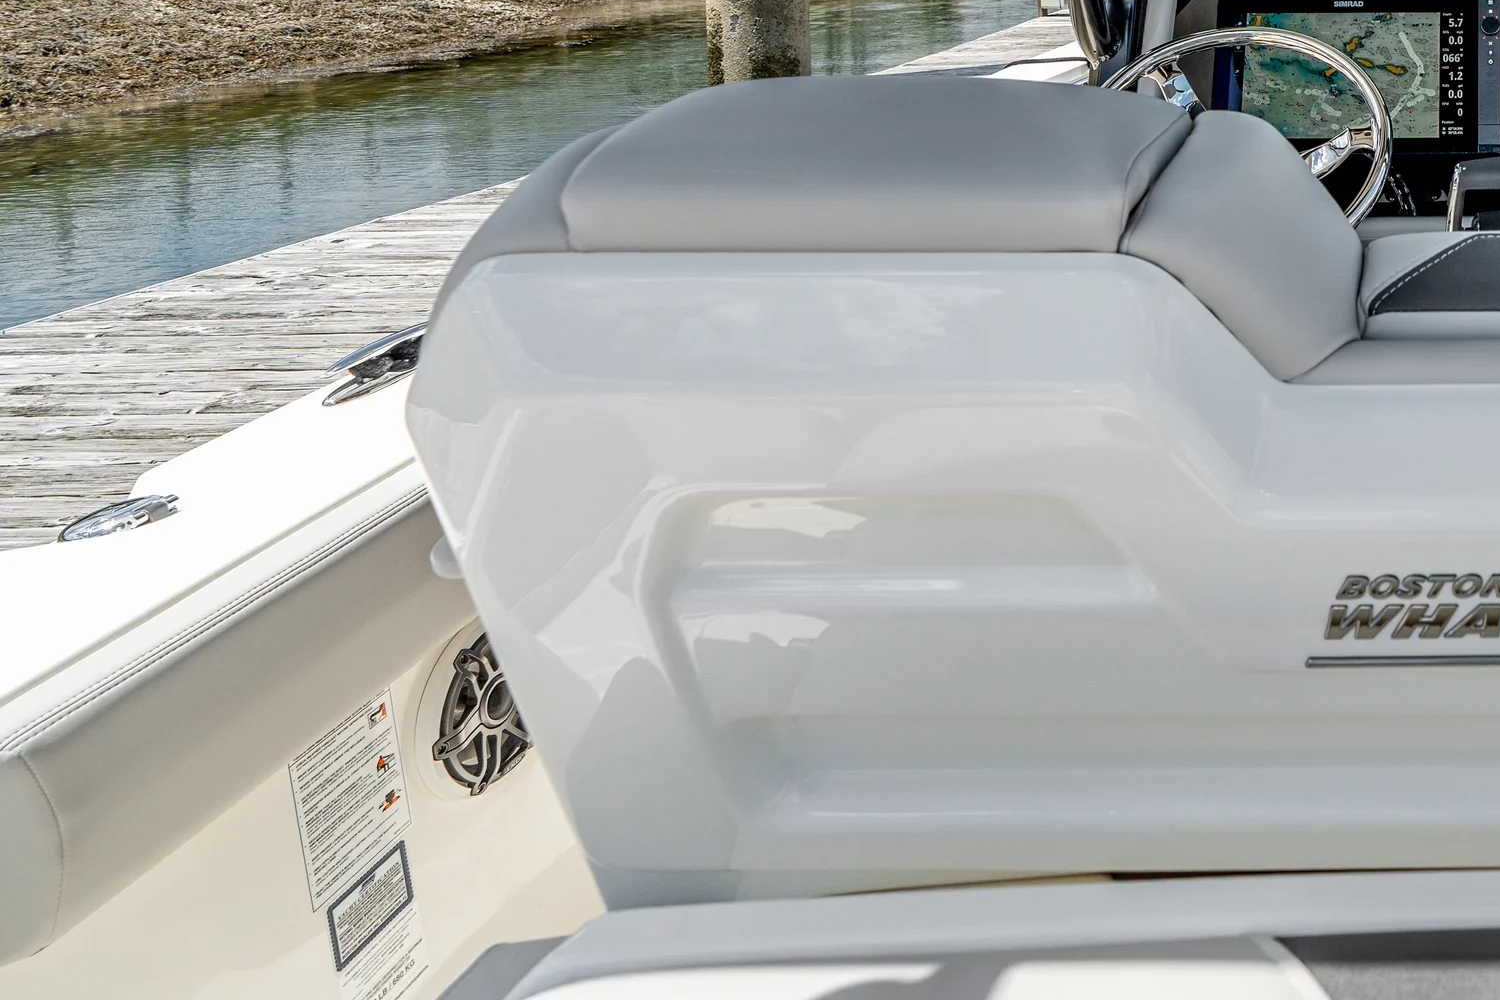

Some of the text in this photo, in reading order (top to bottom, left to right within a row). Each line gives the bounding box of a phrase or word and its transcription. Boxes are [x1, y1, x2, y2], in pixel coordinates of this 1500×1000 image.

[1448, 18, 1463, 27] 5.7
[1448, 36, 1463, 45] 0.0
[1443, 53, 1463, 63] 066°
[1449, 71, 1463, 80] 1.2
[1448, 90, 1463, 98] 0.0
[1457, 108, 1463, 116] 0
[357, 862, 400, 903] CERTIFICATION
[404, 959, 415, 974] KG
